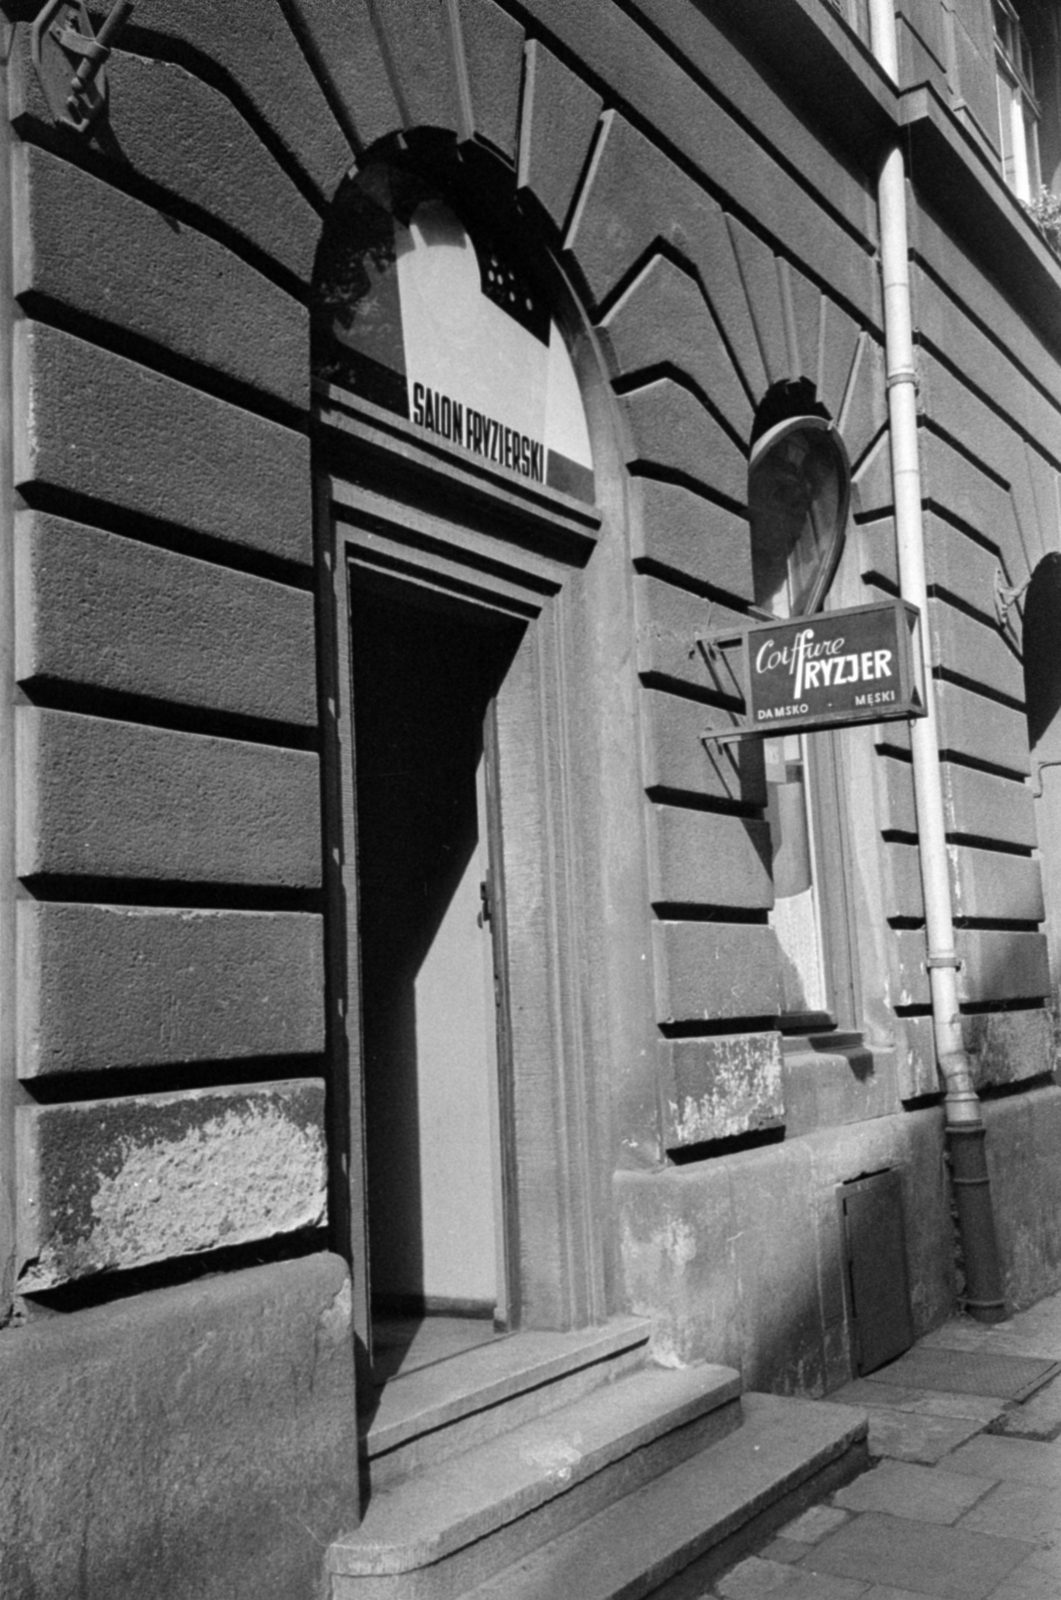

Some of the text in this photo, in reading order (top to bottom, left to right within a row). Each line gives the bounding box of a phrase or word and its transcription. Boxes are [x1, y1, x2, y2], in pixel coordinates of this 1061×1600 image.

[413, 381, 545, 484] SALON FRYZIERSKI
[756, 628, 845, 694] Coiffure
[757, 690, 895, 720] DAMSKO MĘSKI
